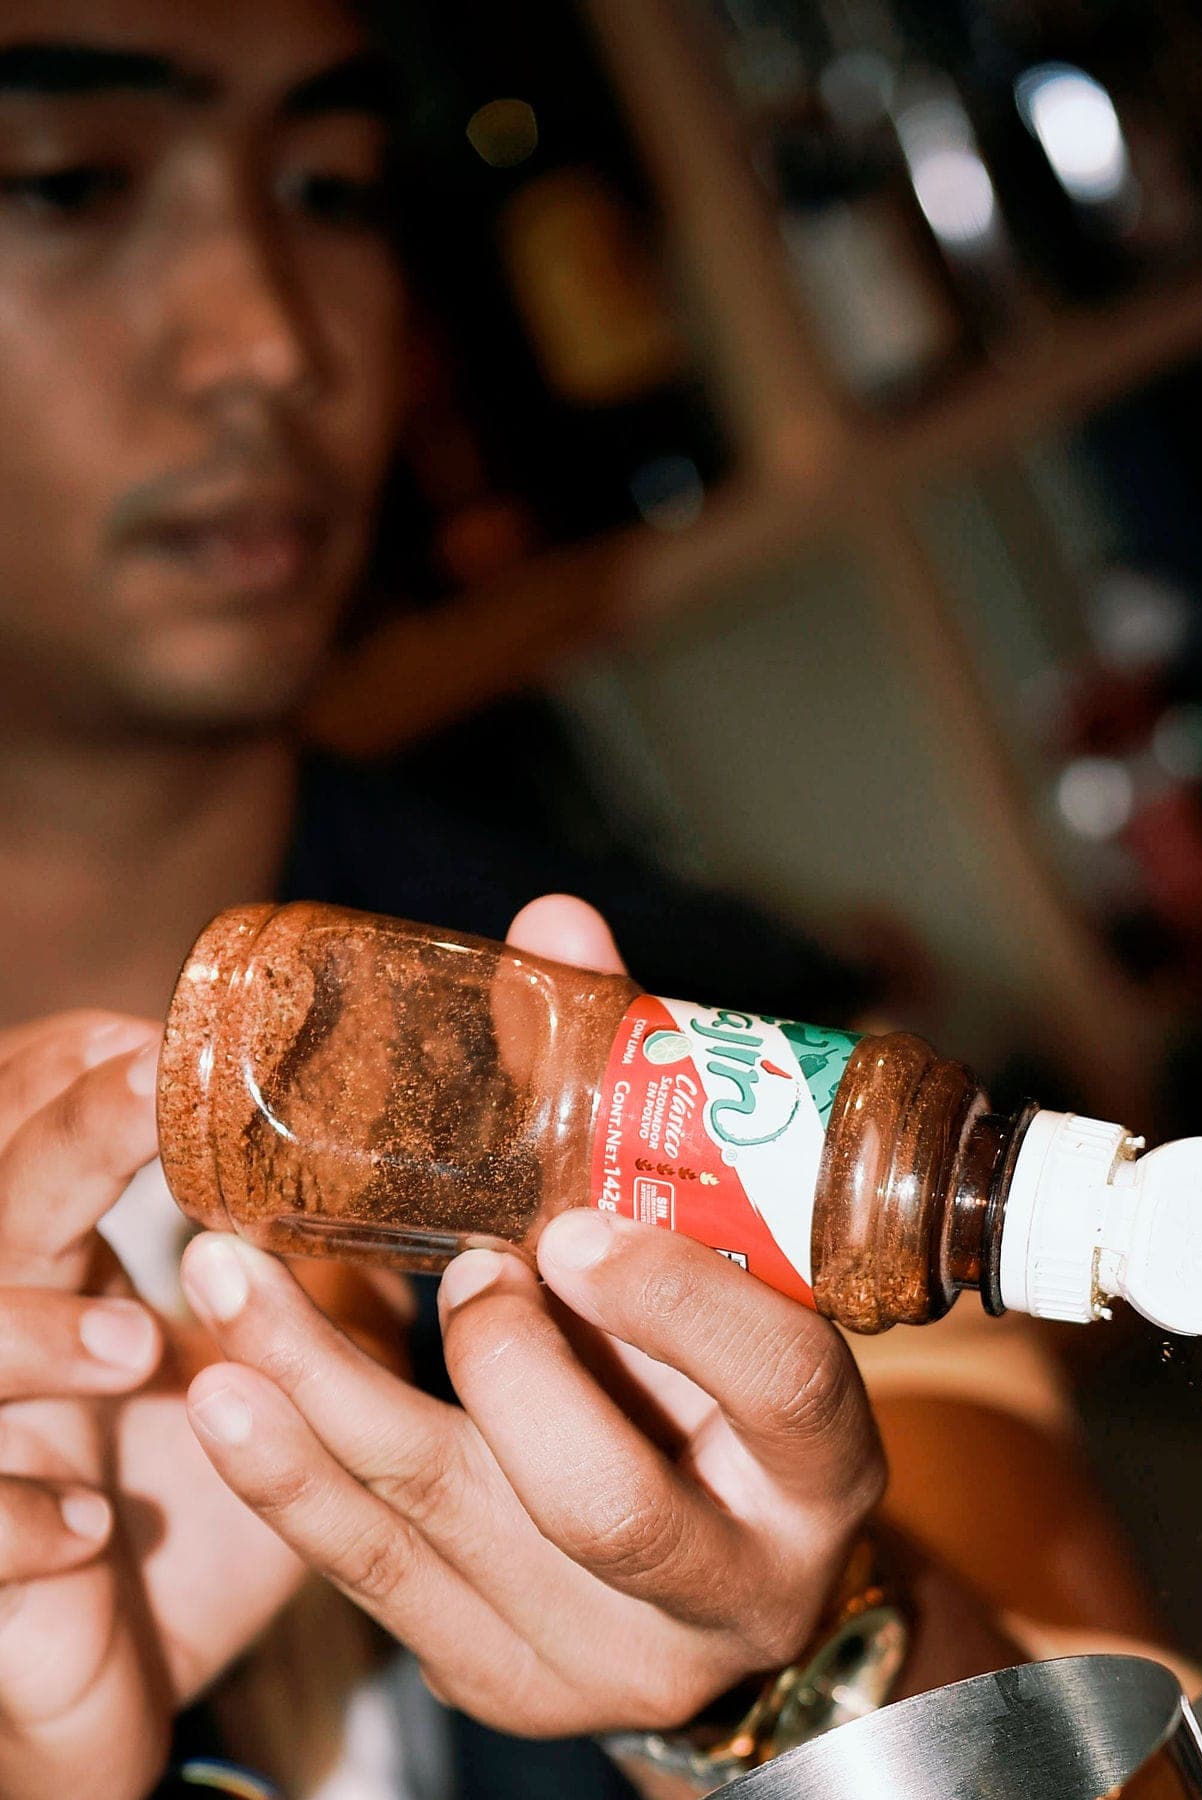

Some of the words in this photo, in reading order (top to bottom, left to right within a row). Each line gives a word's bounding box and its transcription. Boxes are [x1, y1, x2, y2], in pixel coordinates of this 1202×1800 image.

[630, 1019, 647, 1039] CON
[621, 1039, 638, 1064] LIMA
[646, 1081, 658, 1099] EN
[691, 1003, 800, 1146] ajín
[639, 1099, 655, 1139] POLVO
[648, 1075, 673, 1150] SAZONADOR
[664, 1074, 697, 1159] Clásico
[656, 1196, 668, 1219] SIN
